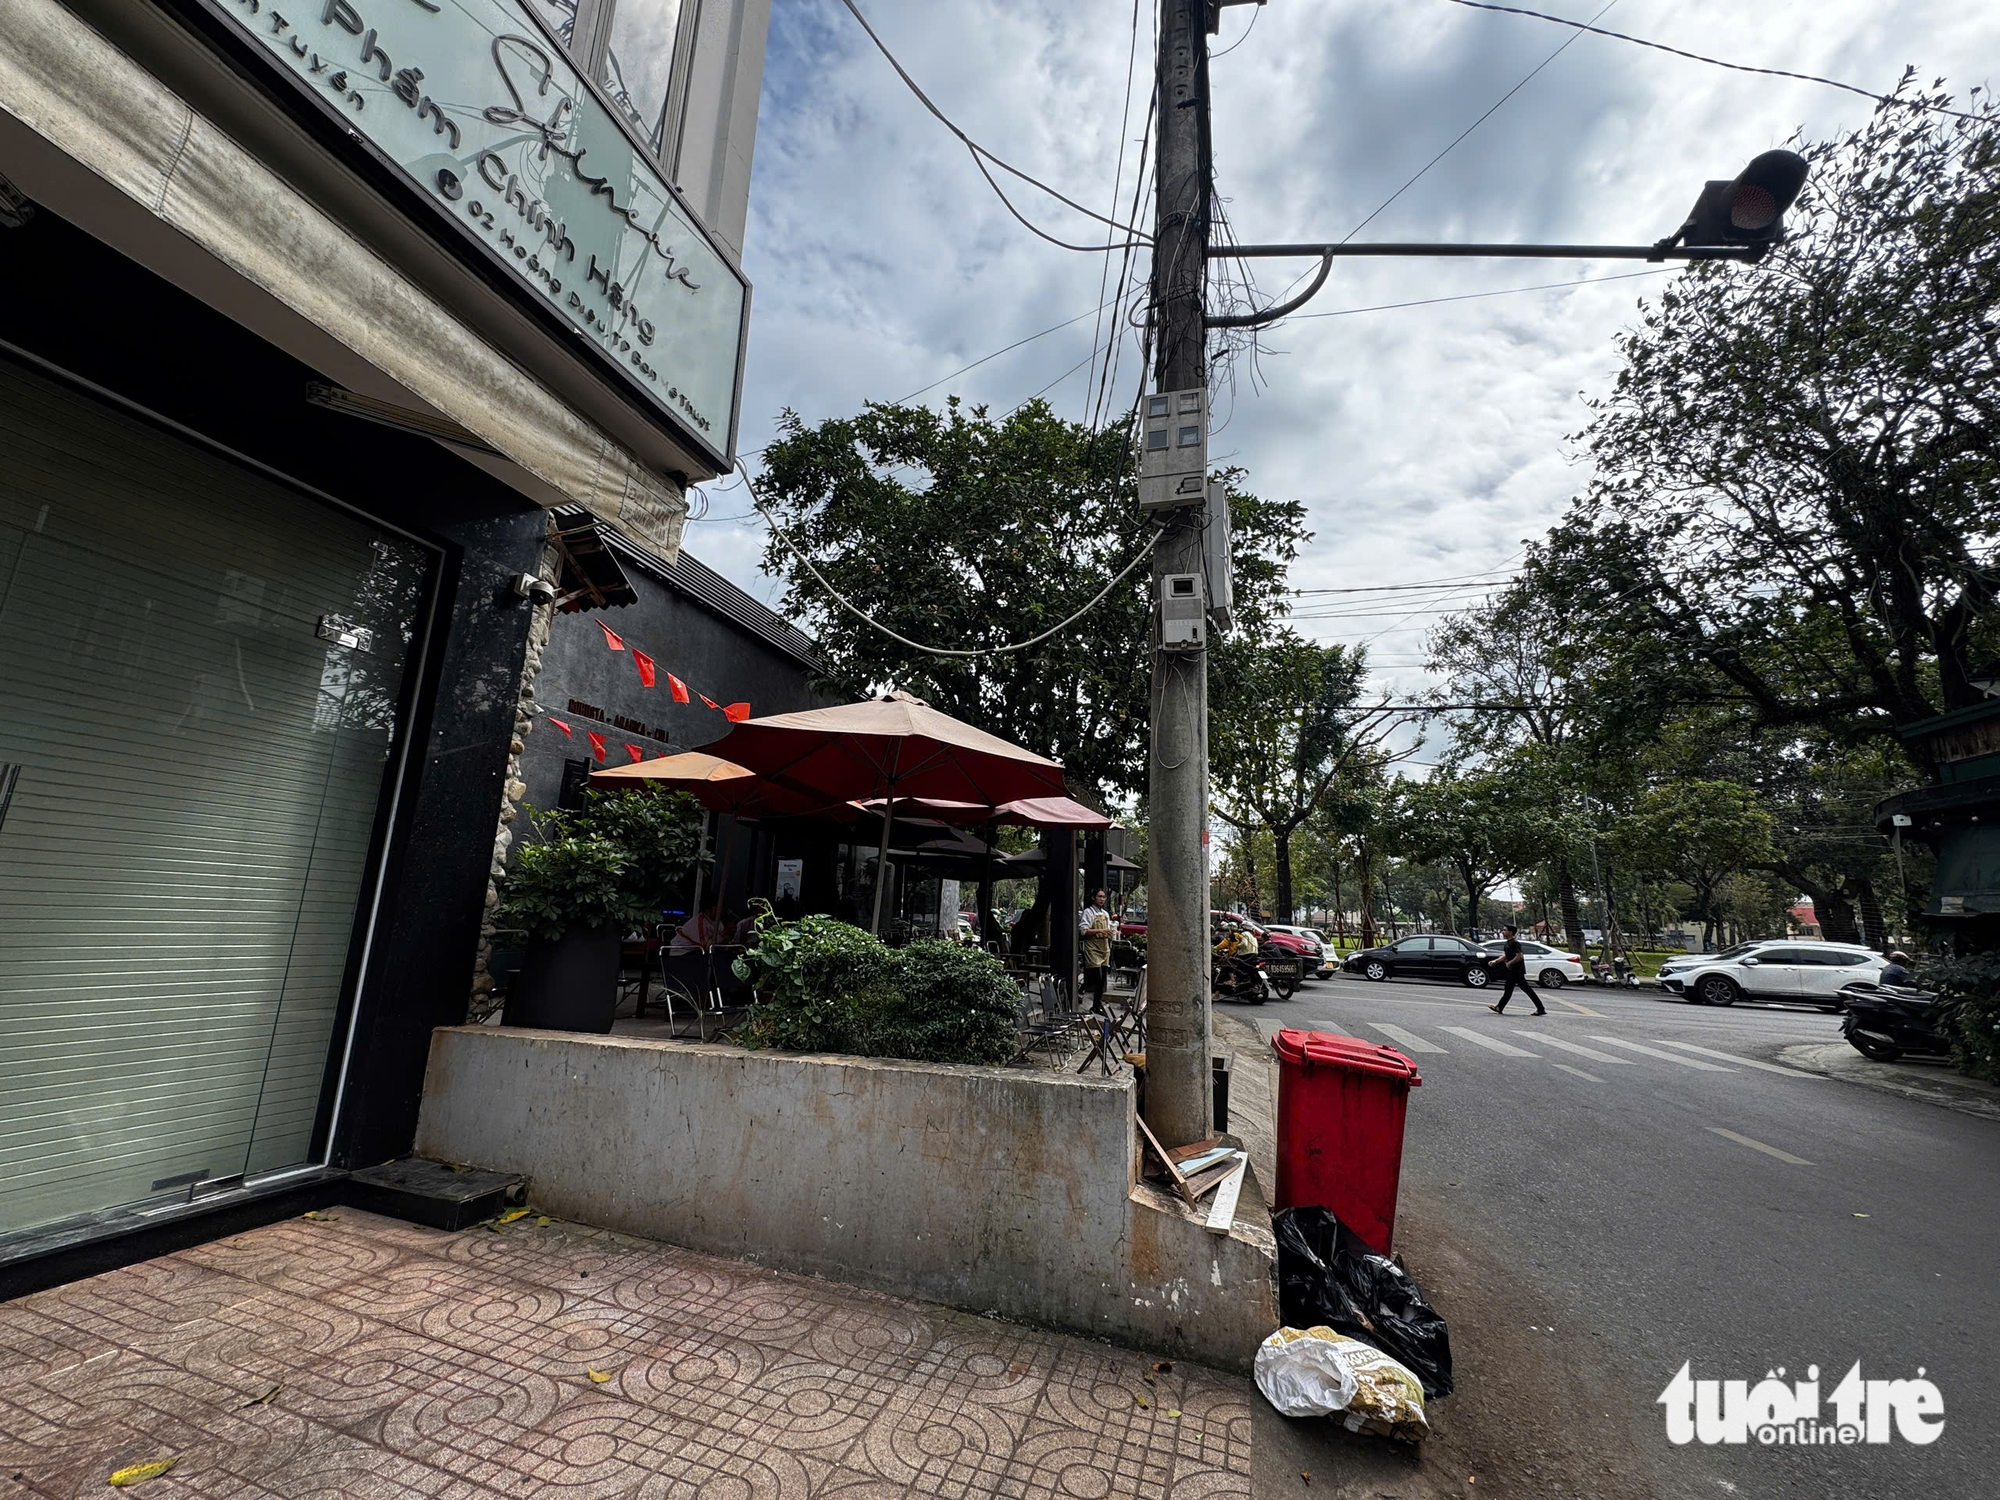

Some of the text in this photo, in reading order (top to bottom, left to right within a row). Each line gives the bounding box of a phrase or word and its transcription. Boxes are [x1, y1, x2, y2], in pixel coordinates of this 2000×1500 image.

[320, 0, 656, 347] Phẩm Chính Hãng
[468, 200, 494, 231] 02
